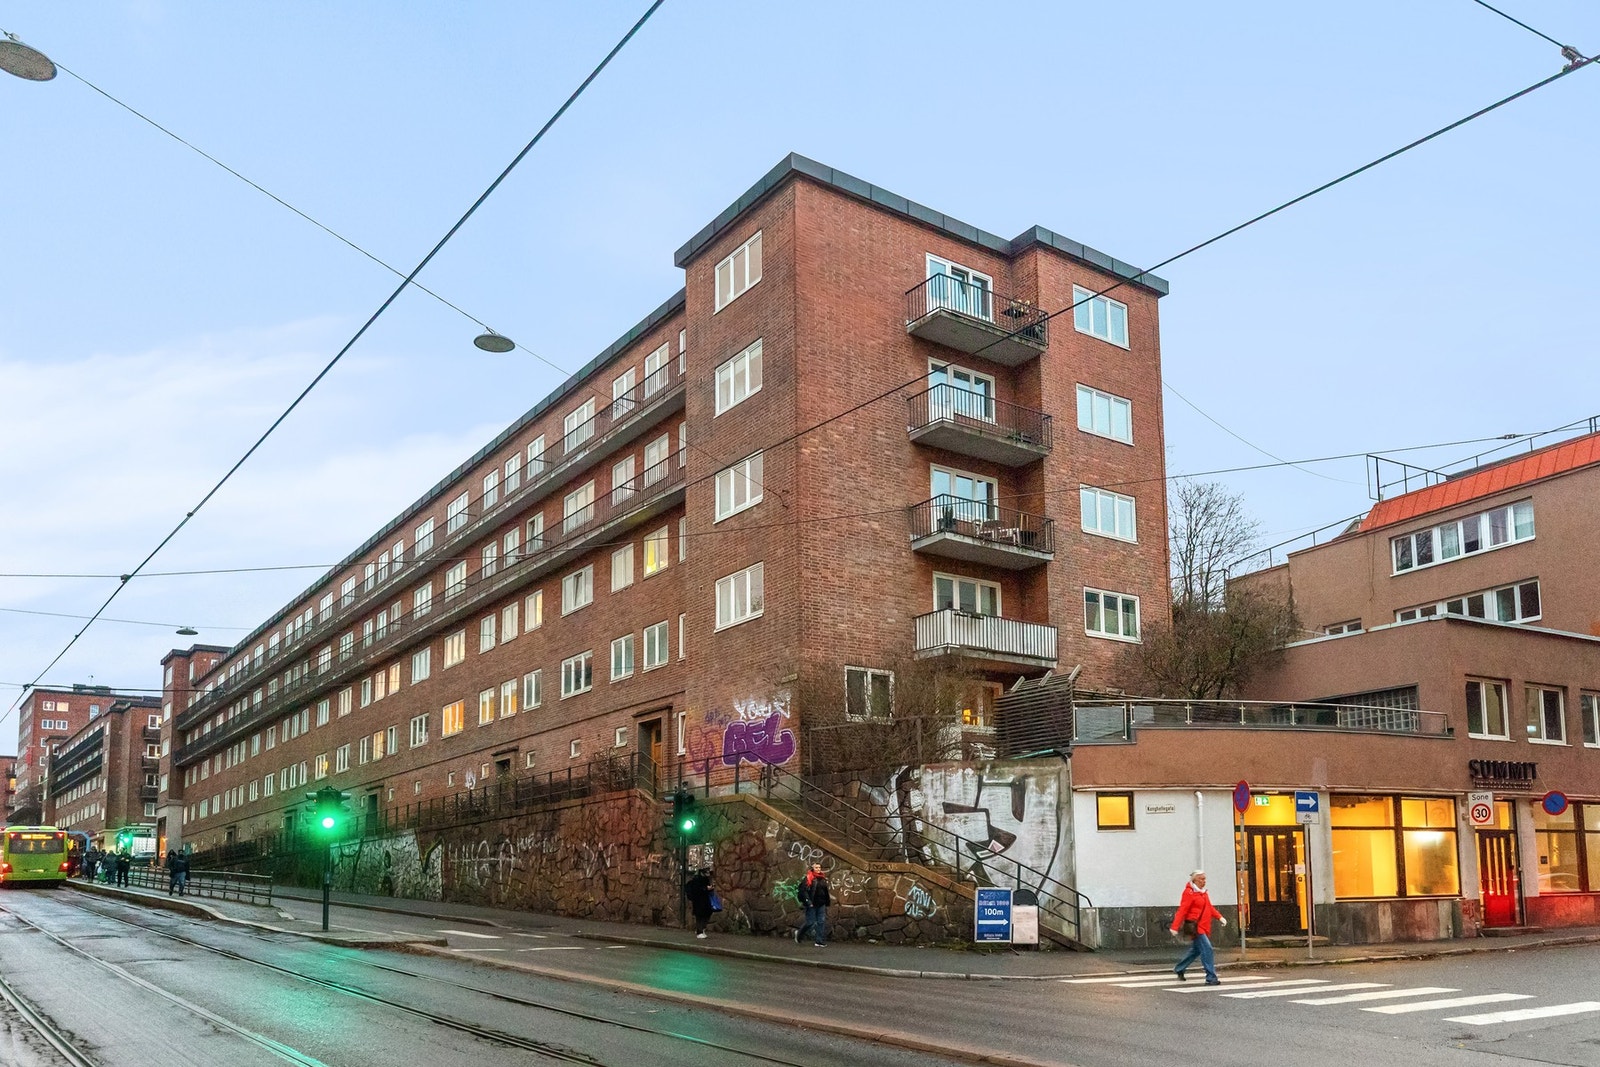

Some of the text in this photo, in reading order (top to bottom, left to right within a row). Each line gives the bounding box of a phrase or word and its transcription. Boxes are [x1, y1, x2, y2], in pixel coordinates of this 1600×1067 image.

[1469, 759, 1538, 780] SUMMIT
[1471, 793, 1489, 801] Sone
[1474, 808, 1488, 819] 30
[984, 908, 1004, 916] 100m
